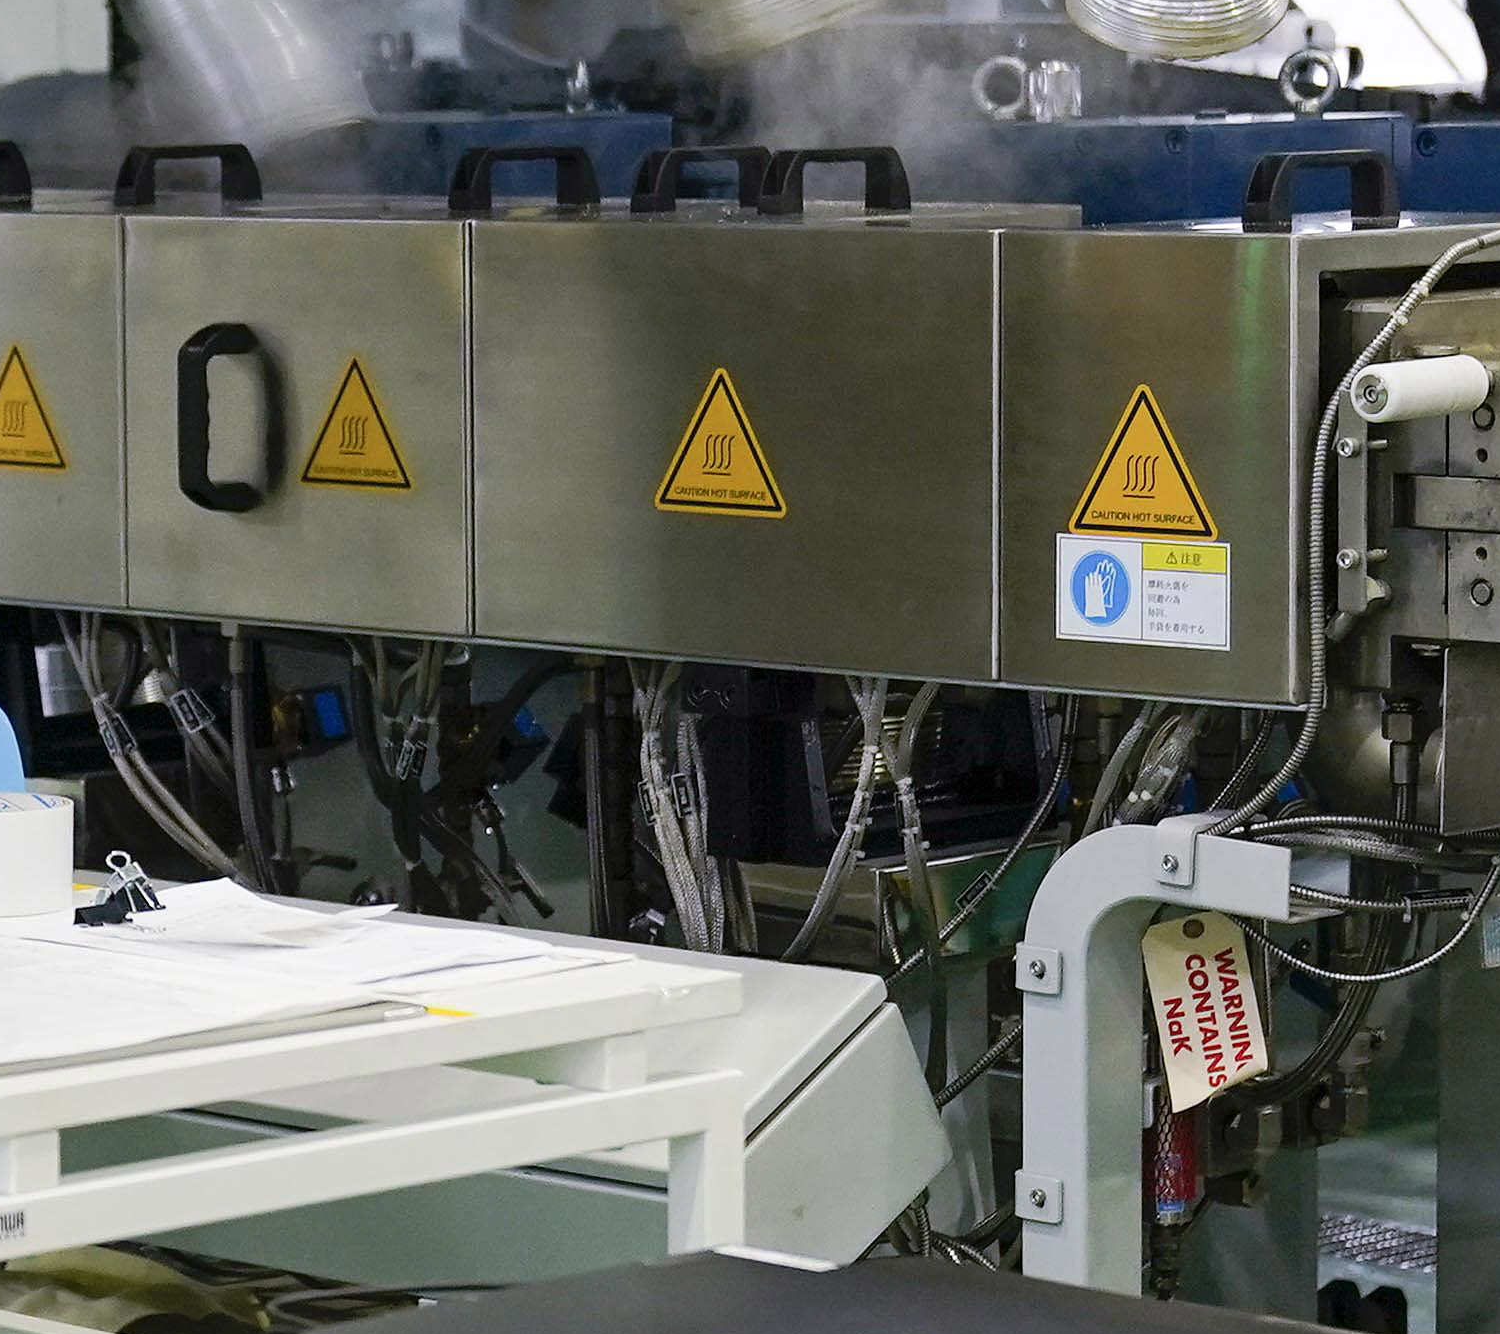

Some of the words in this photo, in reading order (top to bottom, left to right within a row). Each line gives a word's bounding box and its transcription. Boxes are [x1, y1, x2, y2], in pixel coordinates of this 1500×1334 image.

[674, 486, 709, 497] CAUTION
[711, 488, 727, 497] HOT
[729, 489, 766, 500] SURFACE
[1091, 510, 1130, 521] CAUTION
[1132, 513, 1151, 522] HOT
[1153, 514, 1195, 524] SURFACE
[1163, 997, 1193, 1057] NaK
[1186, 954, 1228, 1088] CONTAINS
[1214, 947, 1253, 1072] WARNIN
